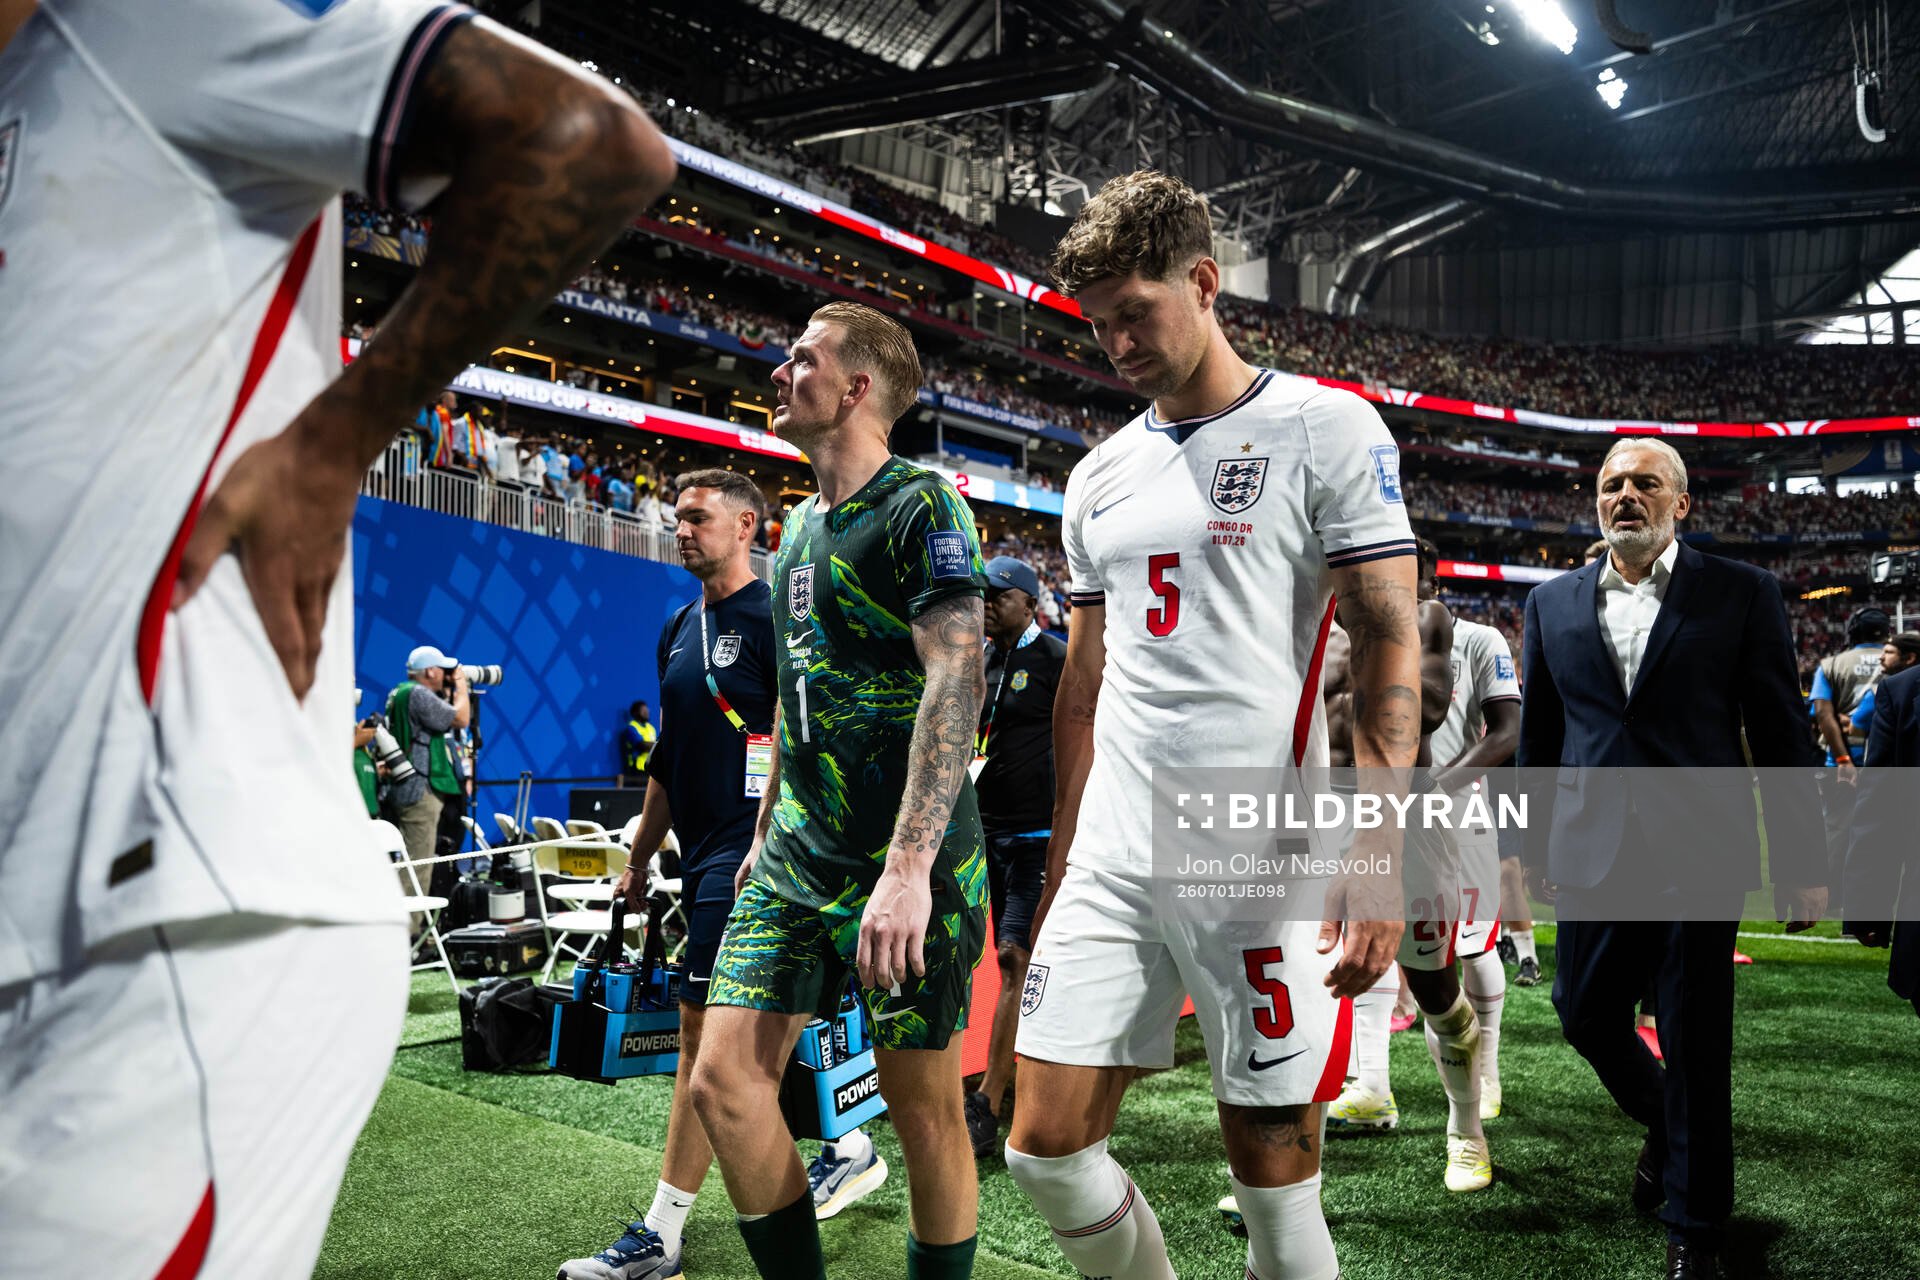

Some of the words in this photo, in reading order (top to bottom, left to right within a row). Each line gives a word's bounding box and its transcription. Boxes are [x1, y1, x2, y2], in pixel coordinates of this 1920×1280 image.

[710, 160, 759, 187] WORLD
[757, 178, 781, 195] CUP
[482, 376, 551, 403] WORLD
[550, 390, 586, 411] CUP
[586, 398, 646, 424] 2026
[964, 400, 993, 418] WORLD
[994, 408, 1011, 421] CUP
[956, 473, 969, 497] 2
[1014, 485, 1031, 508] 1
[934, 538, 962, 546] FOOTBALL
[1207, 521, 1238, 532] CONGO
[1240, 523, 1253, 534] DR
[1212, 535, 1245, 546] 01.07.26
[936, 546, 963, 556] UNITES
[1146, 552, 1180, 637] 5
[795, 675, 811, 744] 1
[573, 860, 592, 870] 169
[1411, 893, 1446, 941] 21
[1463, 888, 1479, 925] 7
[1242, 946, 1295, 1040] 5
[837, 1072, 878, 1109] POWE
